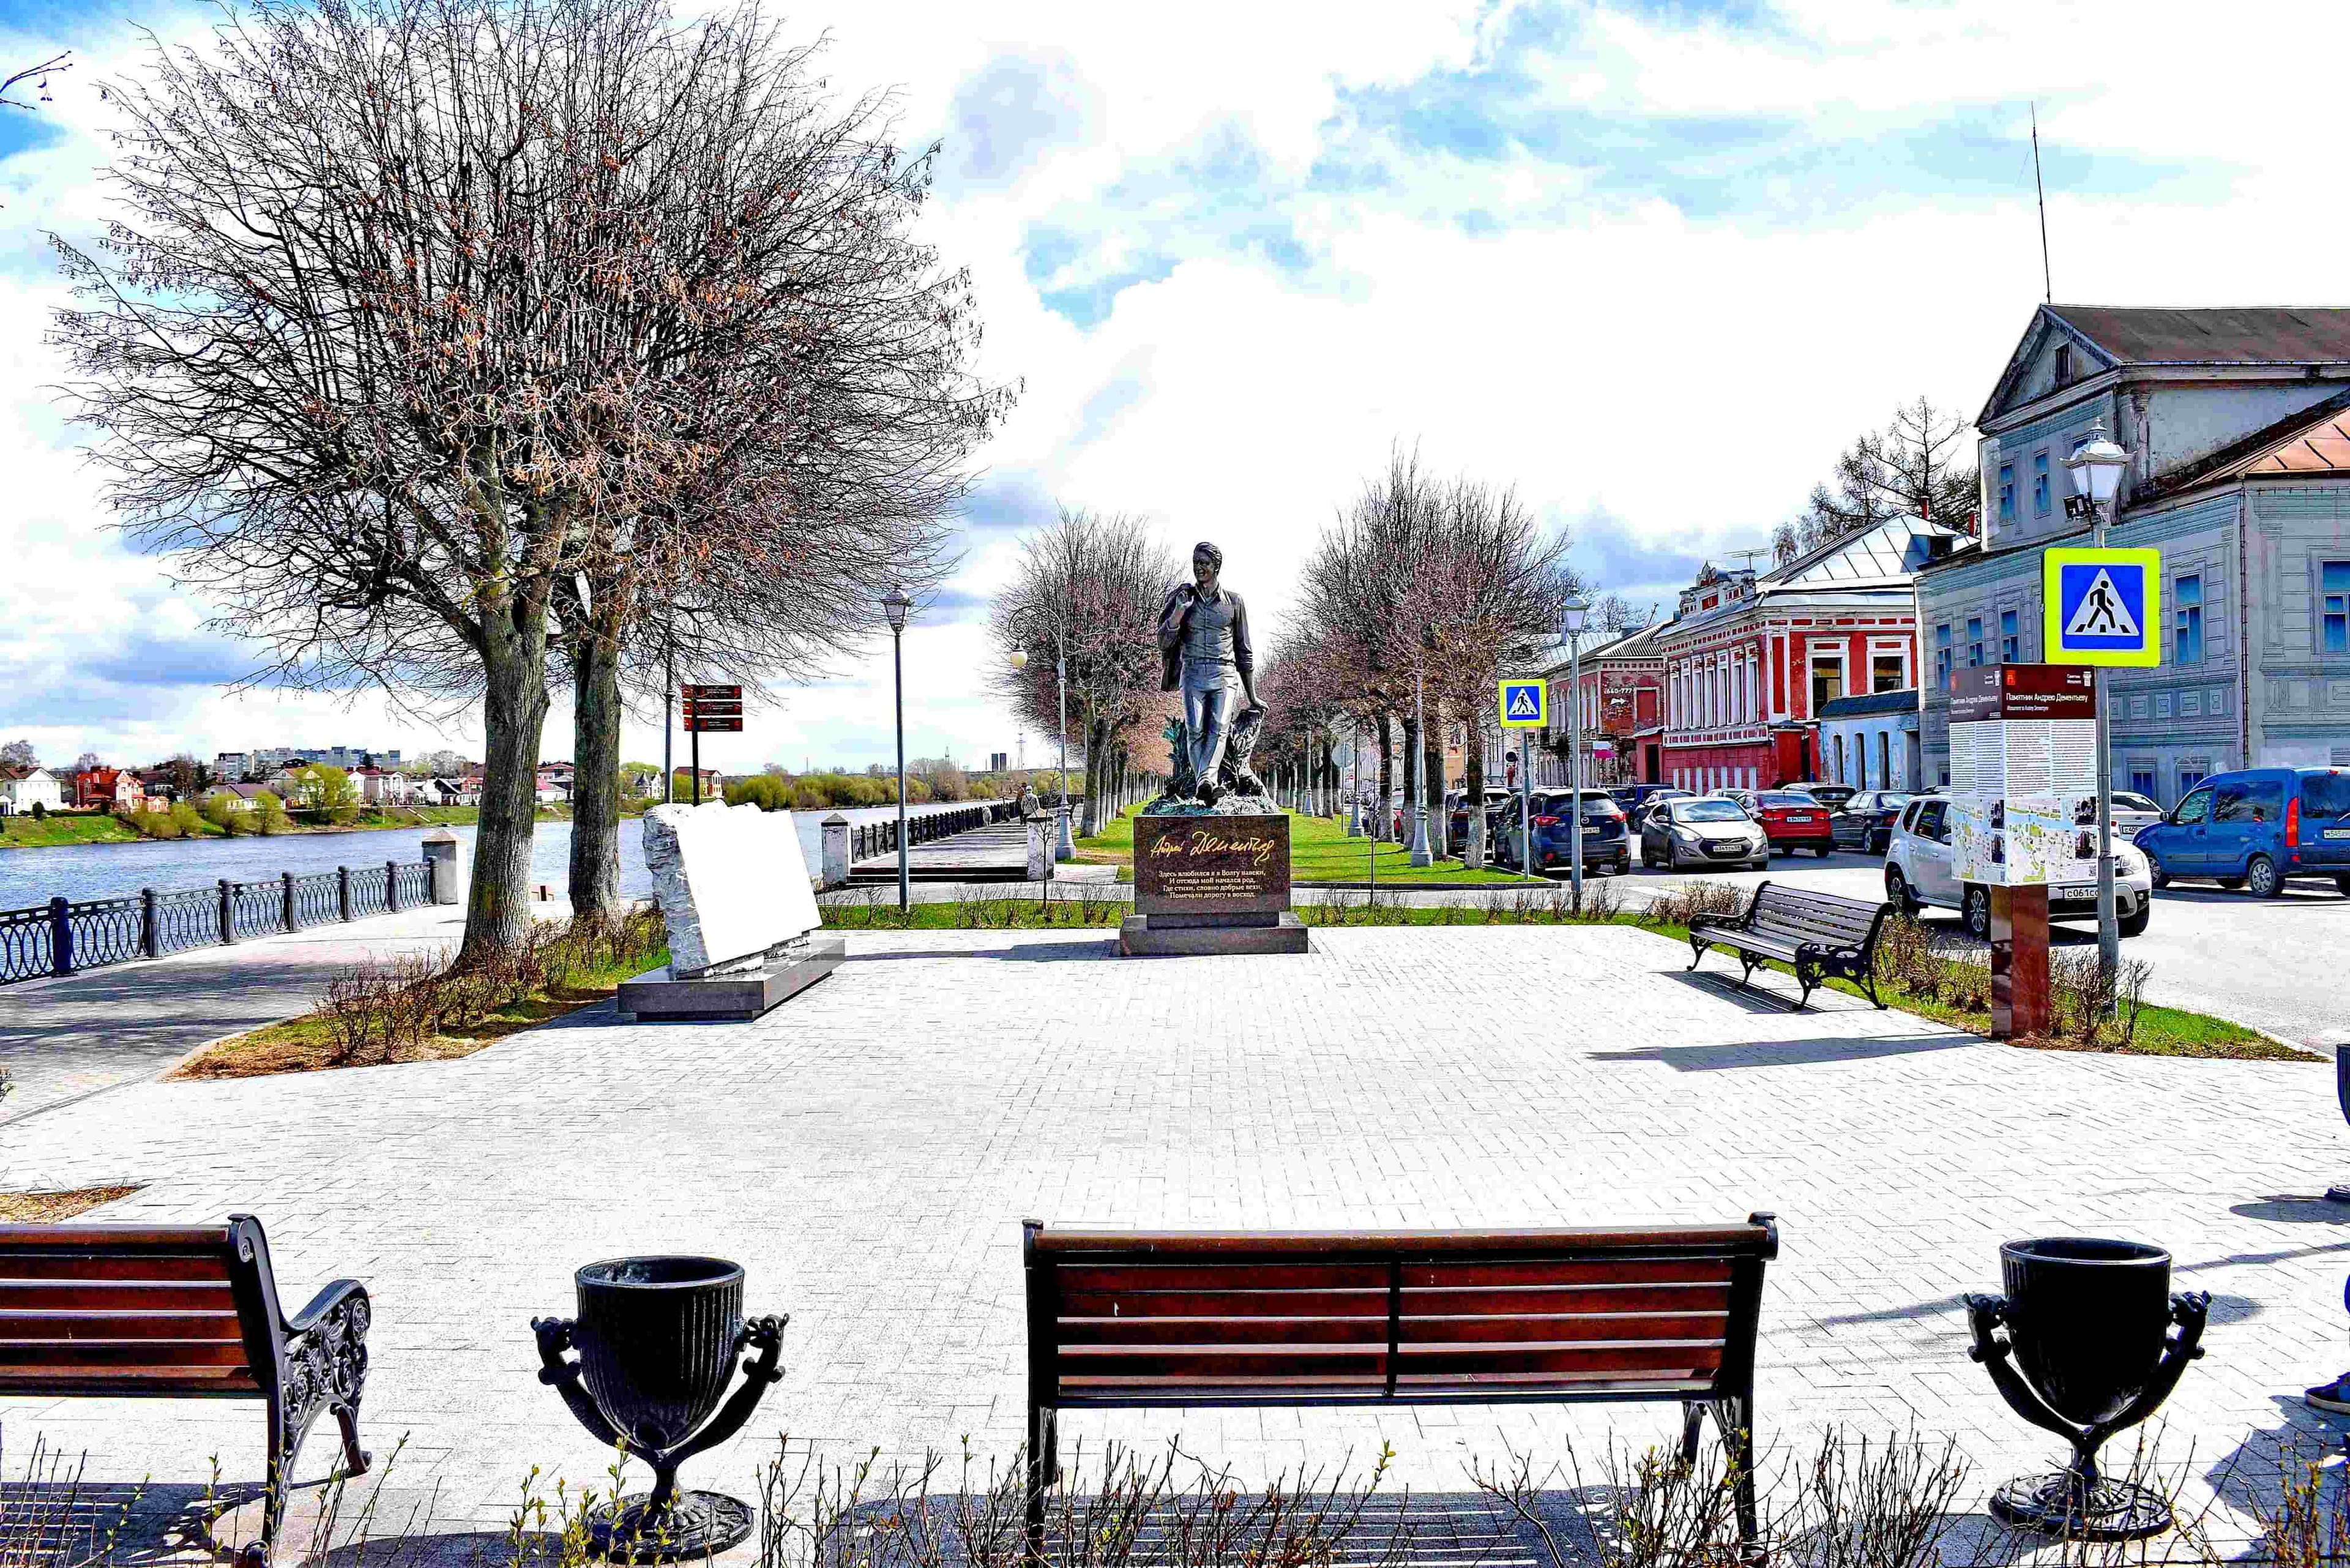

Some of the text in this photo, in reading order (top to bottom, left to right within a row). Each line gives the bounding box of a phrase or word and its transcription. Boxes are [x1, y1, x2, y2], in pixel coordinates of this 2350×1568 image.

[2034, 693, 2056, 703] Андрею
[2056, 693, 2088, 703] Дементьеву
[1150, 835, 1185, 858] Андрей
[1222, 870, 1240, 878] Волгу
